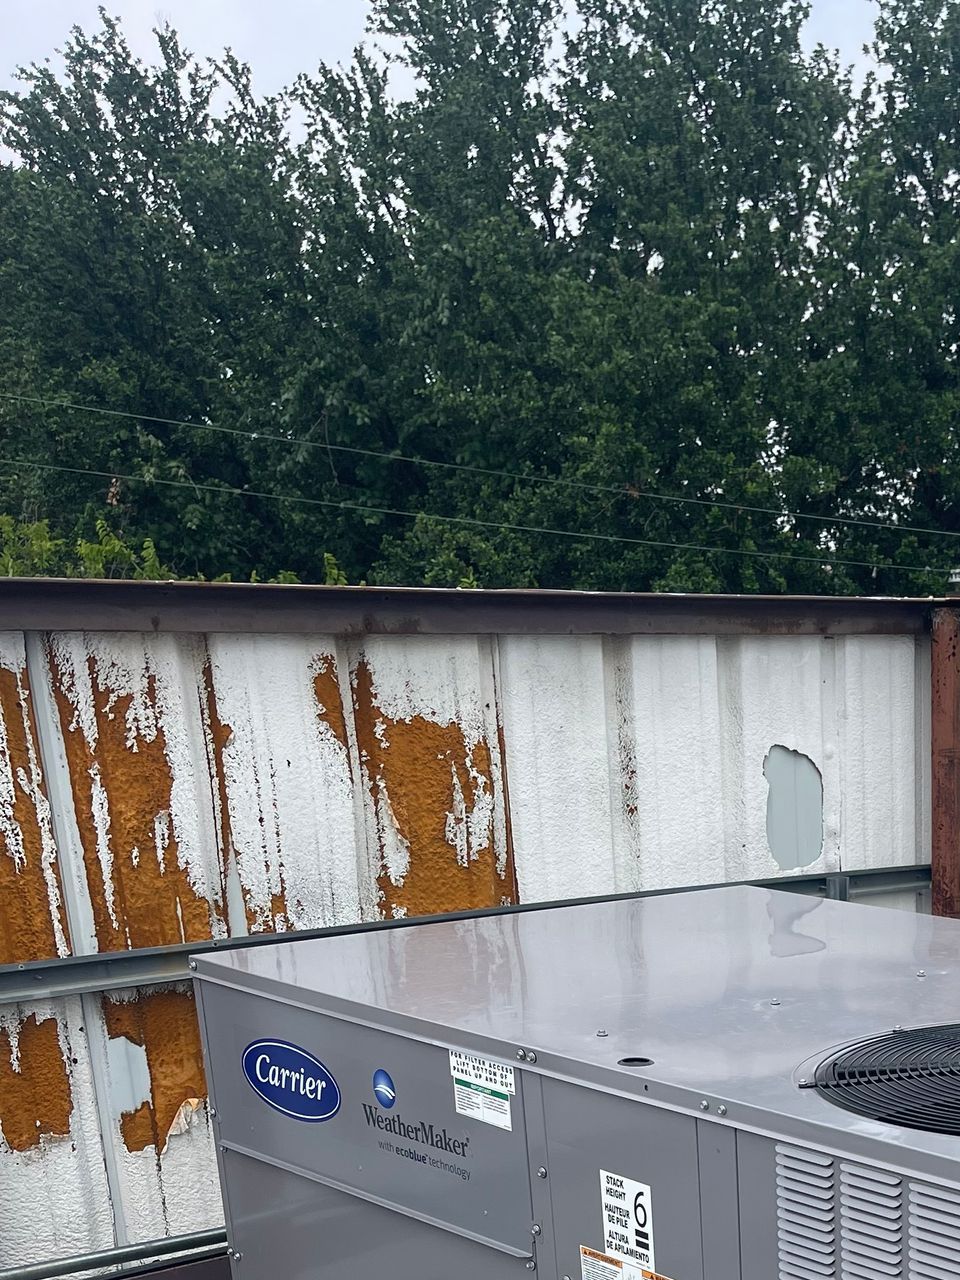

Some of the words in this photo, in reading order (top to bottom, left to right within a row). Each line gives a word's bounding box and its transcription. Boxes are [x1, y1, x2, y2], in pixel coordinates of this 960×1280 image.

[450, 1051, 462, 1060] FOR
[464, 1055, 486, 1067] FILTER
[488, 1062, 513, 1075] ACCESS
[456, 1059, 469, 1068] LIFT
[472, 1064, 497, 1077] BOTTOM
[500, 1072, 508, 1080] OF
[256, 1054, 327, 1101] Carrier
[453, 1065, 472, 1077] PANEL
[485, 1075, 498, 1084] AND
[500, 1080, 513, 1088] OUT
[378, 1140, 395, 1153] with
[428, 1155, 471, 1181] technology
[605, 1175, 625, 1189] STACK
[605, 1186, 626, 1201] HEIGHT
[604, 1202, 630, 1219] HAUTEUR
[633, 1191, 647, 1228] 6
[607, 1213, 616, 1223] DE
[616, 1216, 629, 1229] PILE
[608, 1229, 630, 1245] ALTURA
[606, 1239, 613, 1250] DE
[614, 1242, 650, 1264] APILAMIENTO
